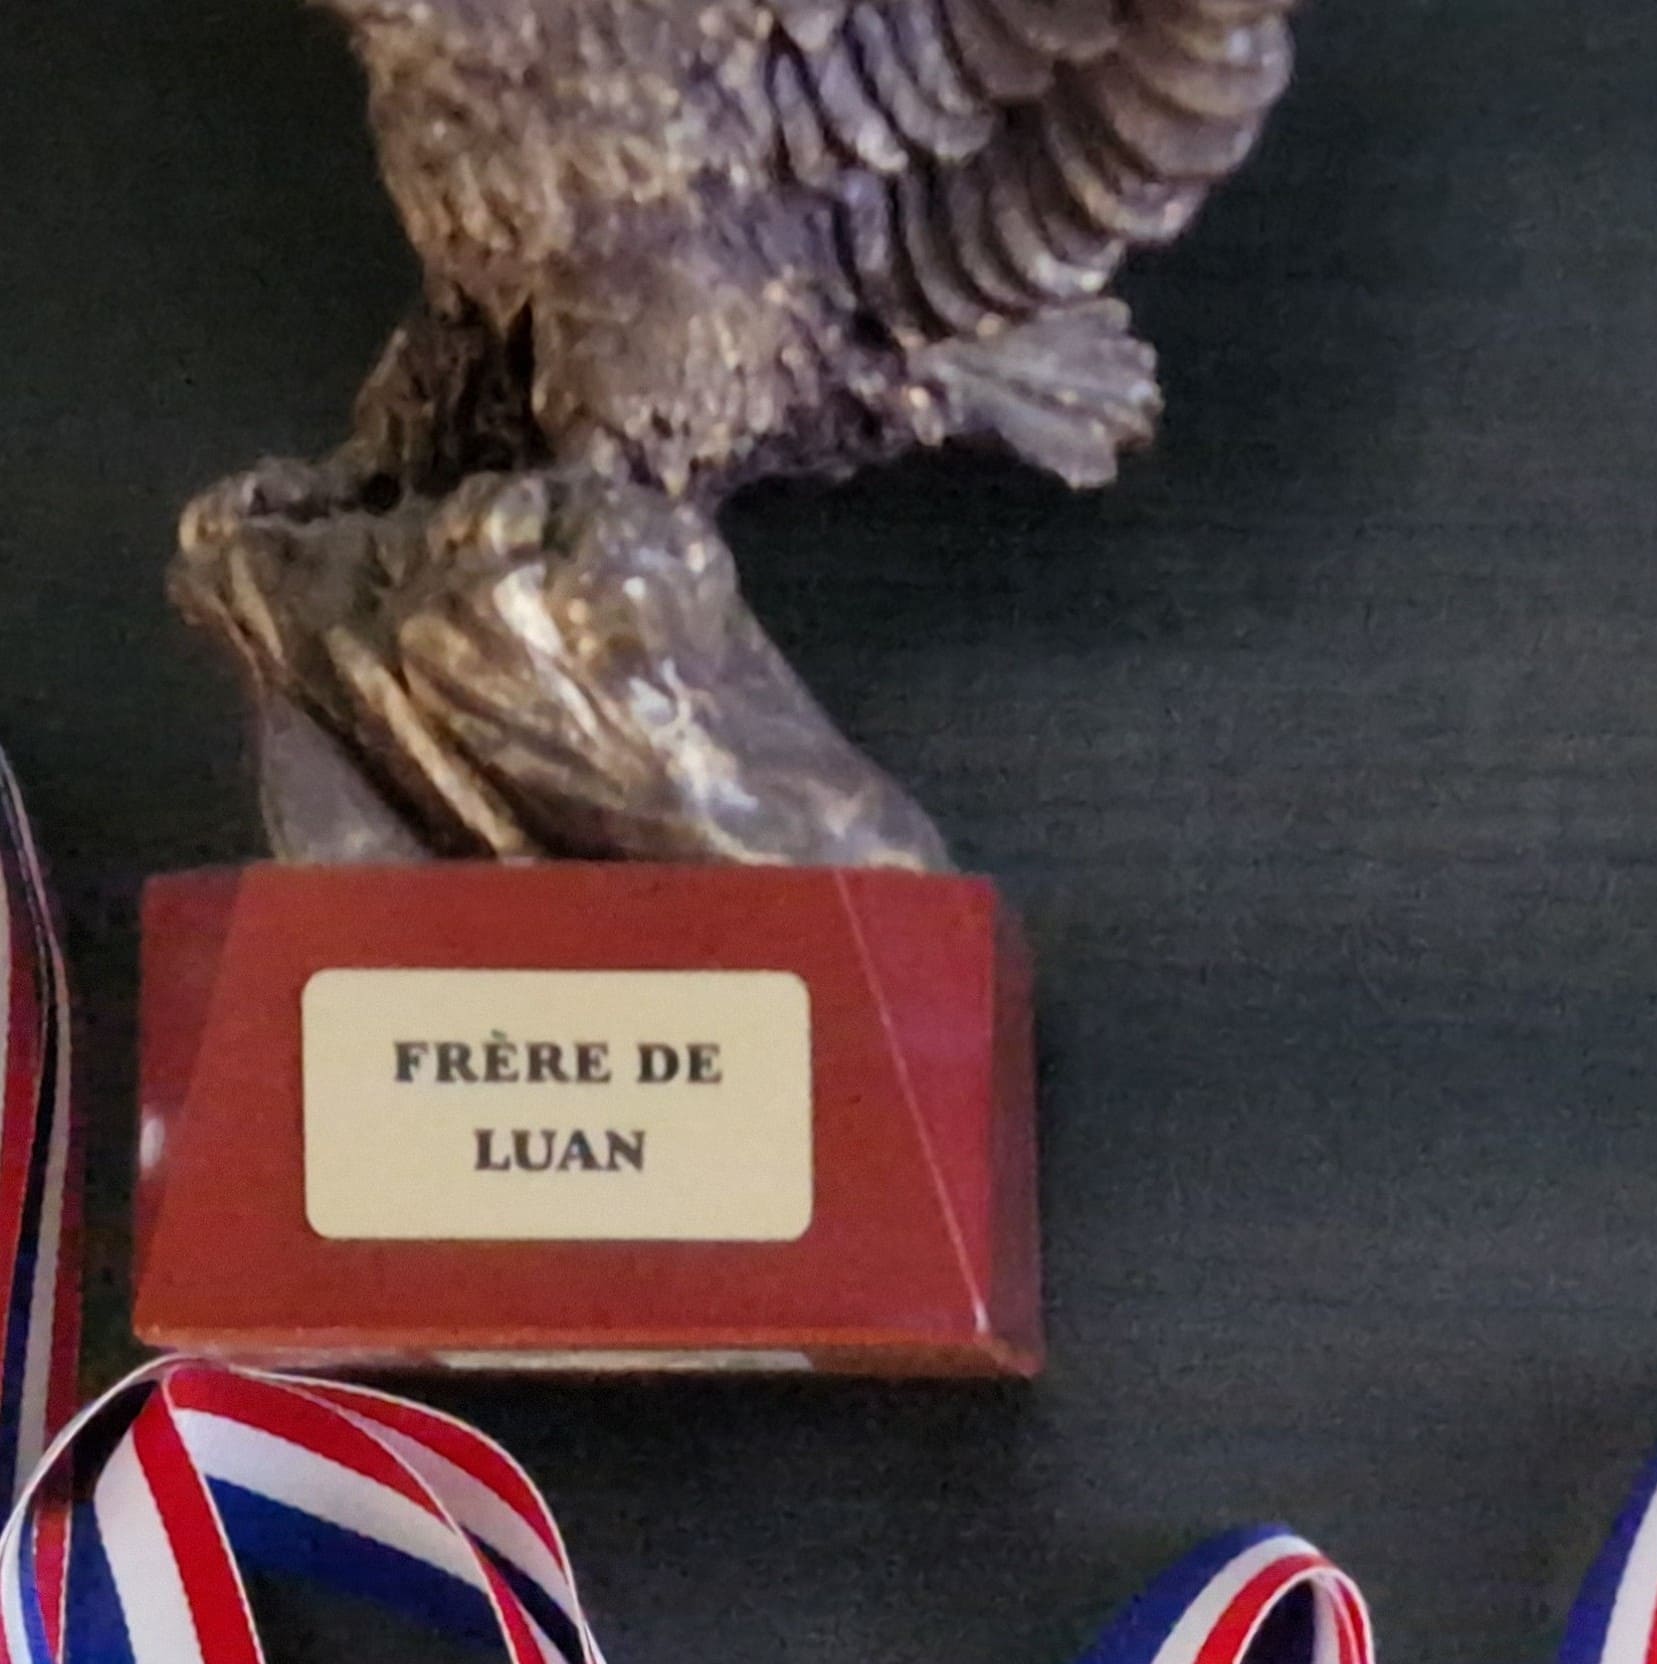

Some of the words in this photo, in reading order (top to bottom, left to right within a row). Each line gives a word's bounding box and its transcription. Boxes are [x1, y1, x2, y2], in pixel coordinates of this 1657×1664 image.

[393, 1028, 612, 1084] FRÈRE
[636, 1041, 724, 1084] DE
[473, 1128, 646, 1172] LUAN
